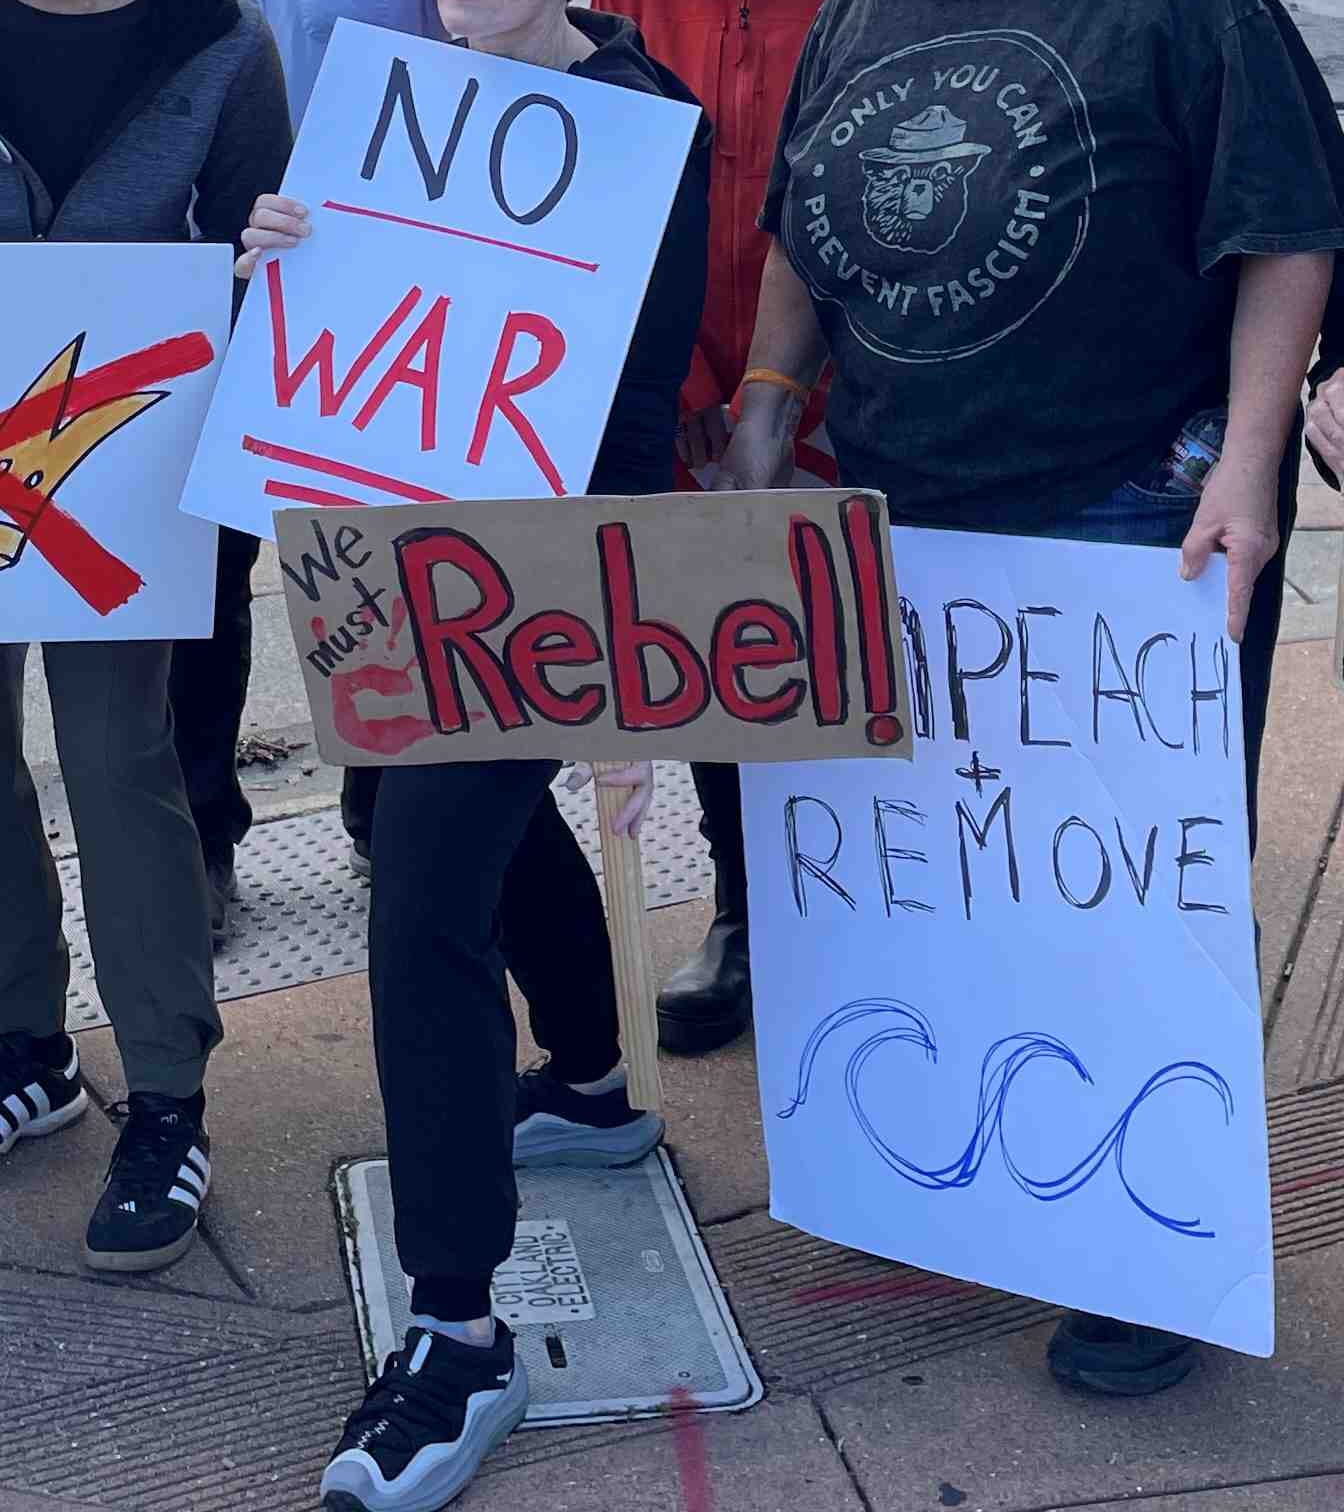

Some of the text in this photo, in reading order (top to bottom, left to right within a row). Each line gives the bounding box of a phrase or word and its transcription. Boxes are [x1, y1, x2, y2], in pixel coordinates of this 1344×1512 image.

[361, 57, 578, 225] NO
[829, 64, 1048, 150] ONLY YOU CAN
[804, 188, 1051, 317] PREVENT FASCISM
[266, 258, 568, 497] WAR
[281, 519, 372, 601] We
[392, 495, 904, 746] Rebel!
[899, 594, 1231, 758] PEACH
[785, 787, 1231, 922] REMOVE
[513, 1235, 557, 1307] OAKLAND
[541, 1232, 589, 1306] ELECTRIC
